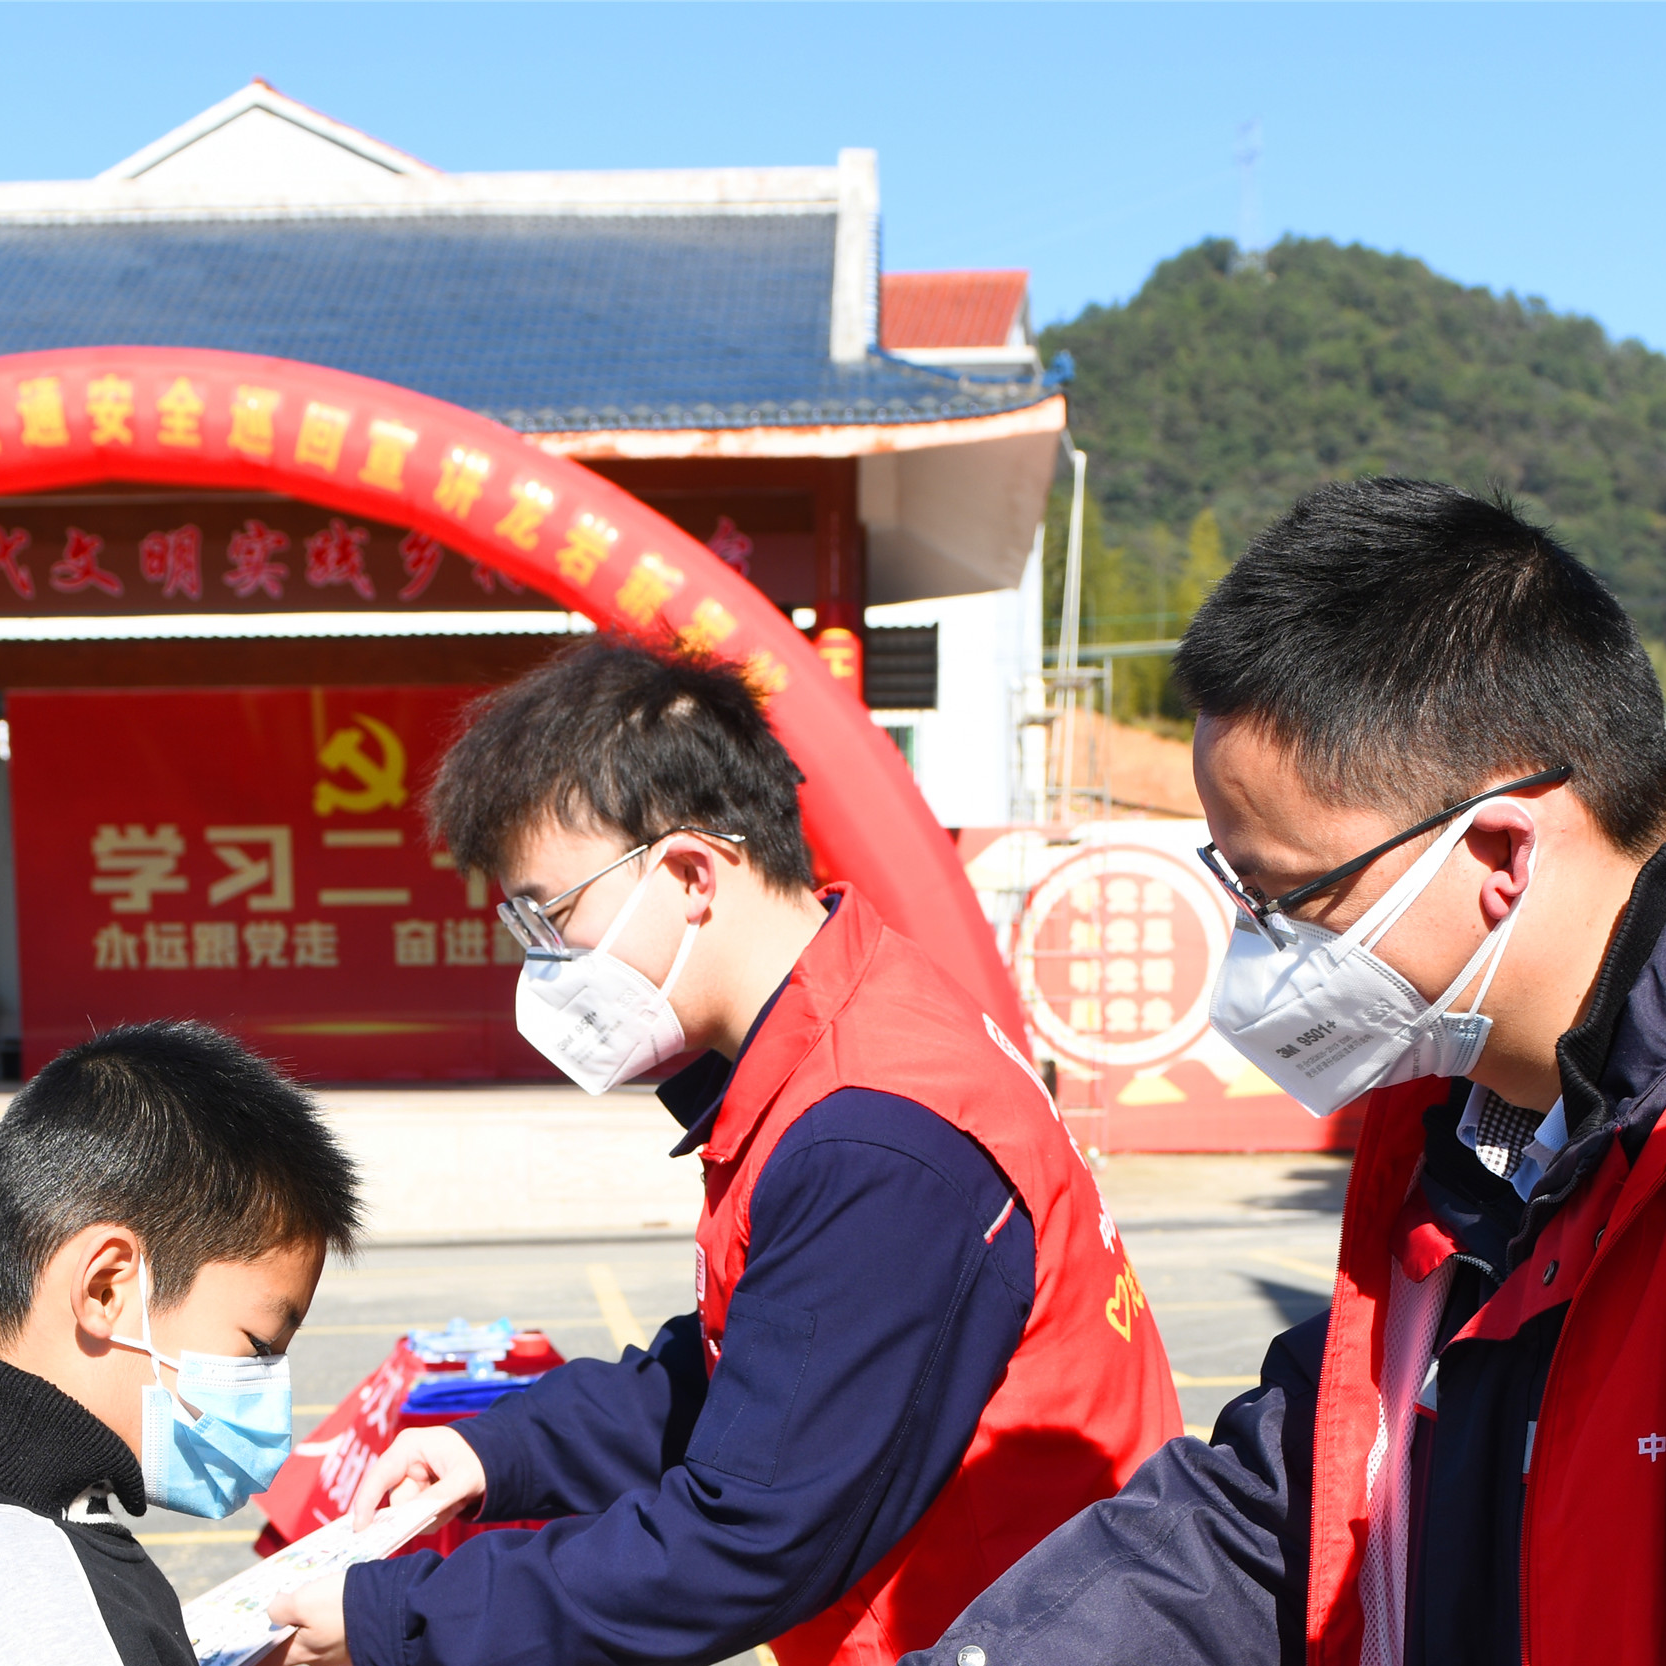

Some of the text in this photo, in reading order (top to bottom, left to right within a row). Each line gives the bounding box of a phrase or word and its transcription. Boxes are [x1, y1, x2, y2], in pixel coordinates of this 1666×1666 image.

[94, 922, 339, 970] 永远跟党走
[1275, 1019, 1338, 1059] 3M 9501+
